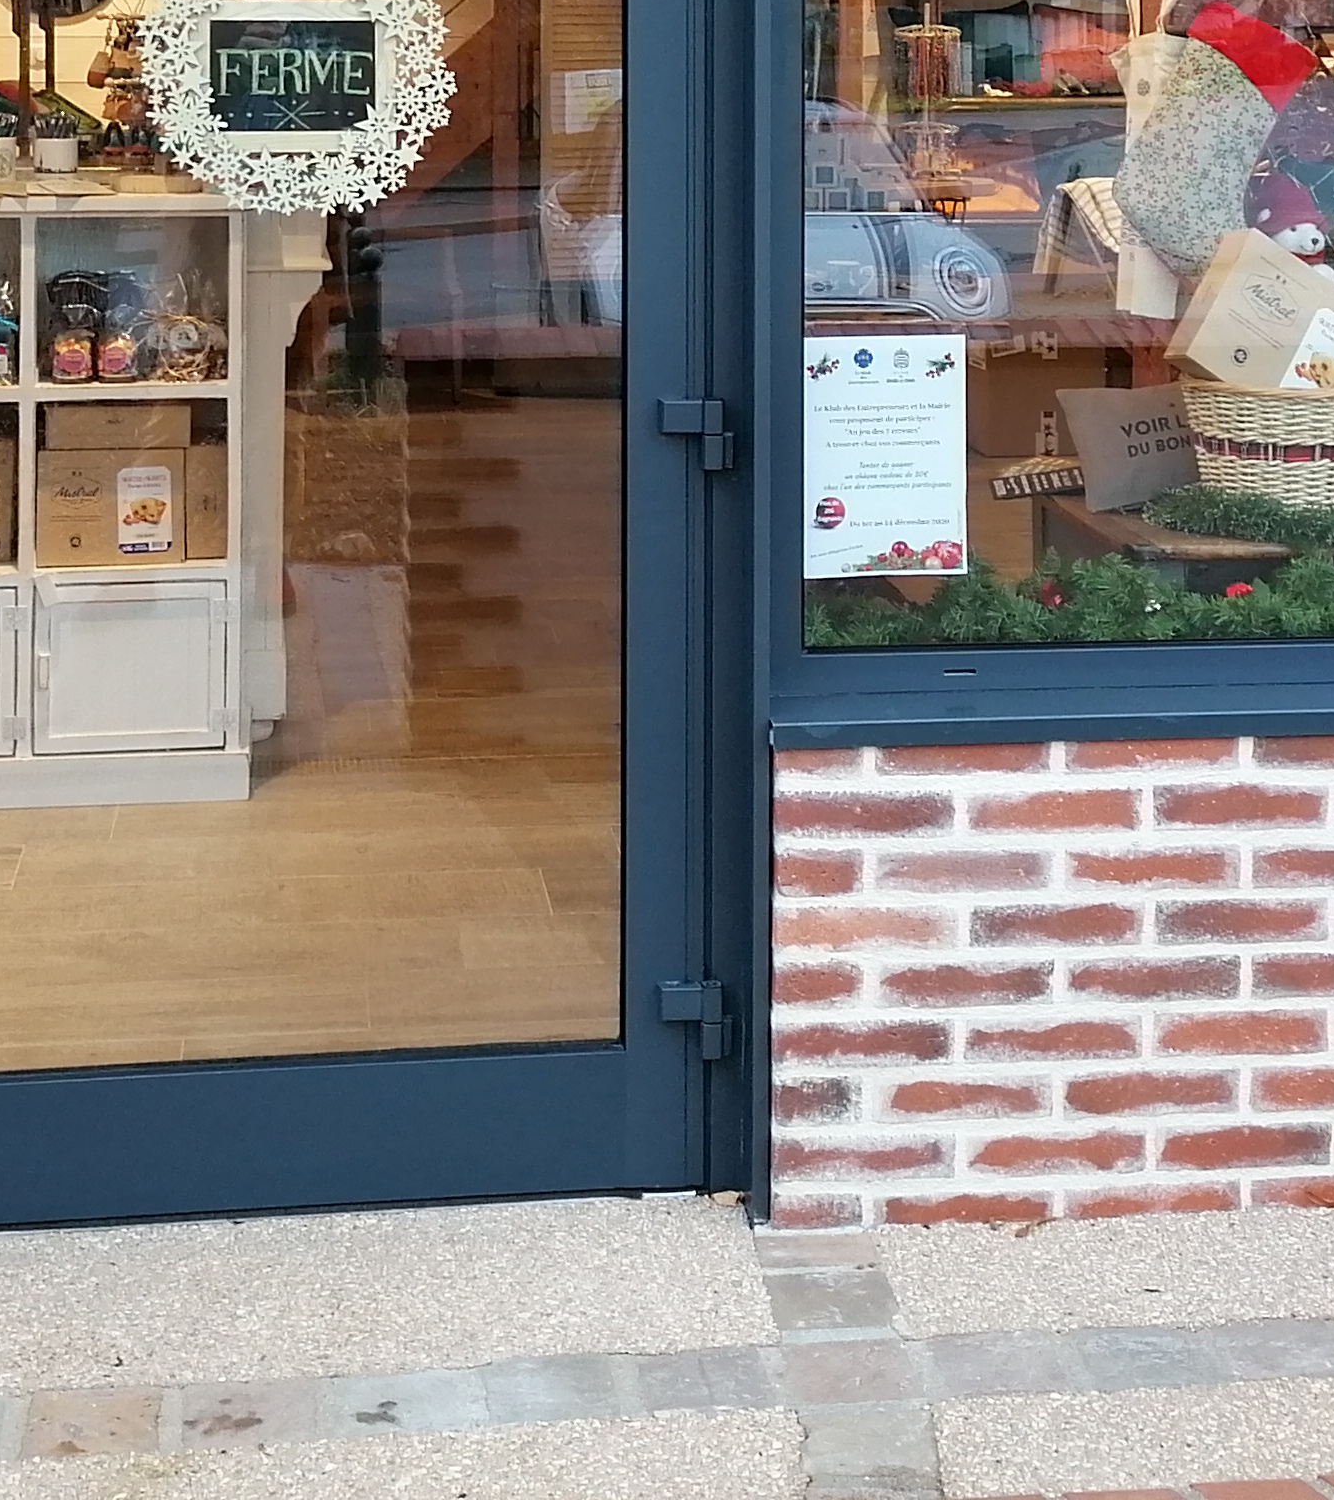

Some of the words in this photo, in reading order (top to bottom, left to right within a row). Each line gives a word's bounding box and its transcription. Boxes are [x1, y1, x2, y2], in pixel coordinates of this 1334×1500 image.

[214, 46, 374, 98] FERME
[1244, 283, 1297, 320] Mistral
[1120, 416, 1173, 438] VOIR
[1175, 415, 1191, 429] L
[1127, 441, 1150, 458] DU
[1155, 435, 1192, 453] BON
